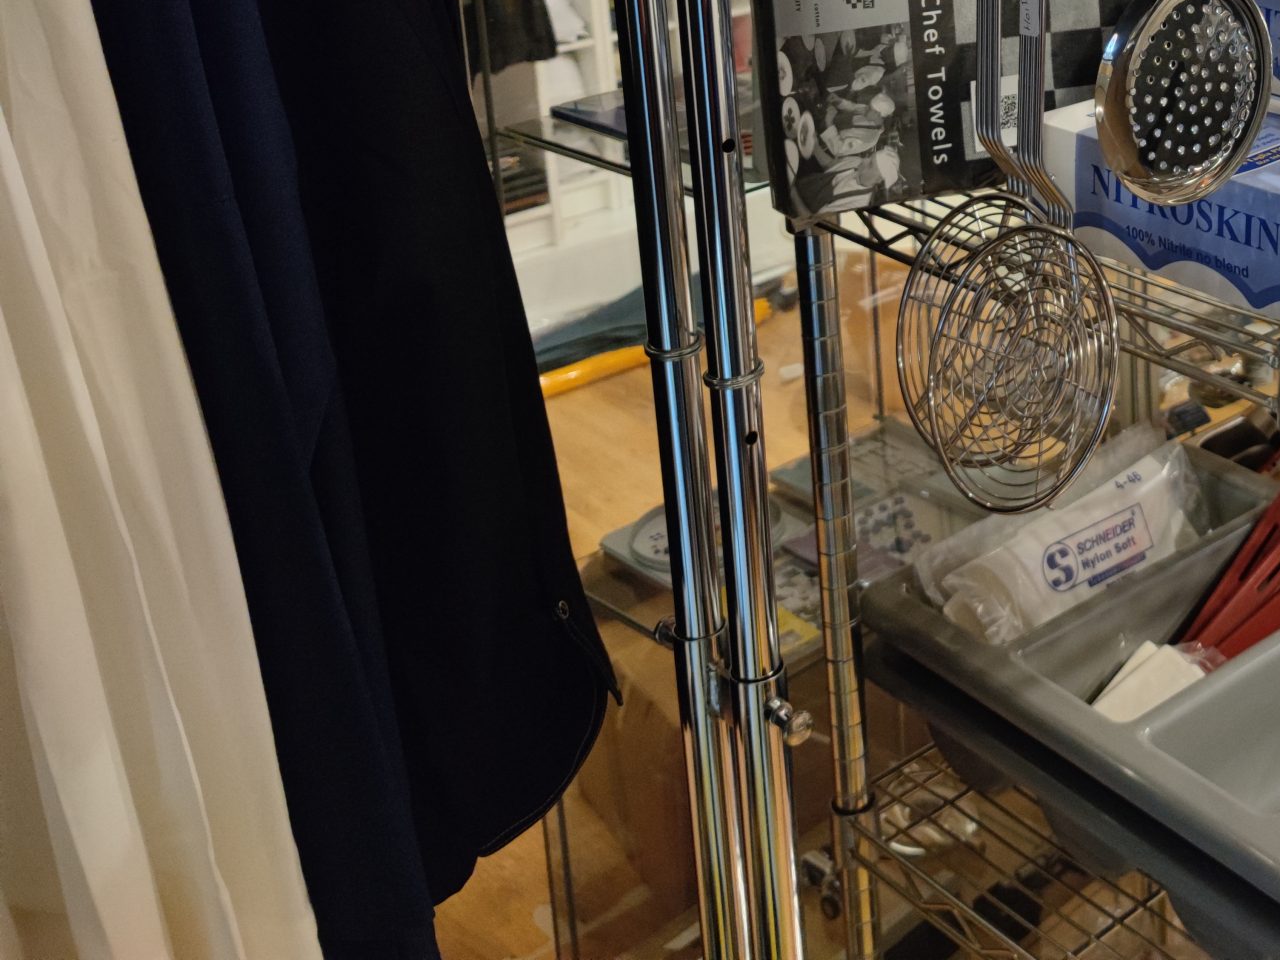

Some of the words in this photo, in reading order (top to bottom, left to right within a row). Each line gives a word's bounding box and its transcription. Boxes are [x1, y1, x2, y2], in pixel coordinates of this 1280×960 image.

[927, 66, 952, 165] Towels
[1125, 225, 1156, 246] 100%
[1159, 235, 1193, 258] Nitrile
[1196, 251, 1211, 265] no
[1216, 256, 1249, 278] blend
[1115, 471, 1142, 489] 4-46
[1077, 517, 1136, 555] SCHNEIDER
[1081, 548, 1112, 570] Nylon
[1114, 536, 1136, 554] Soft
[1046, 547, 1074, 587] S
